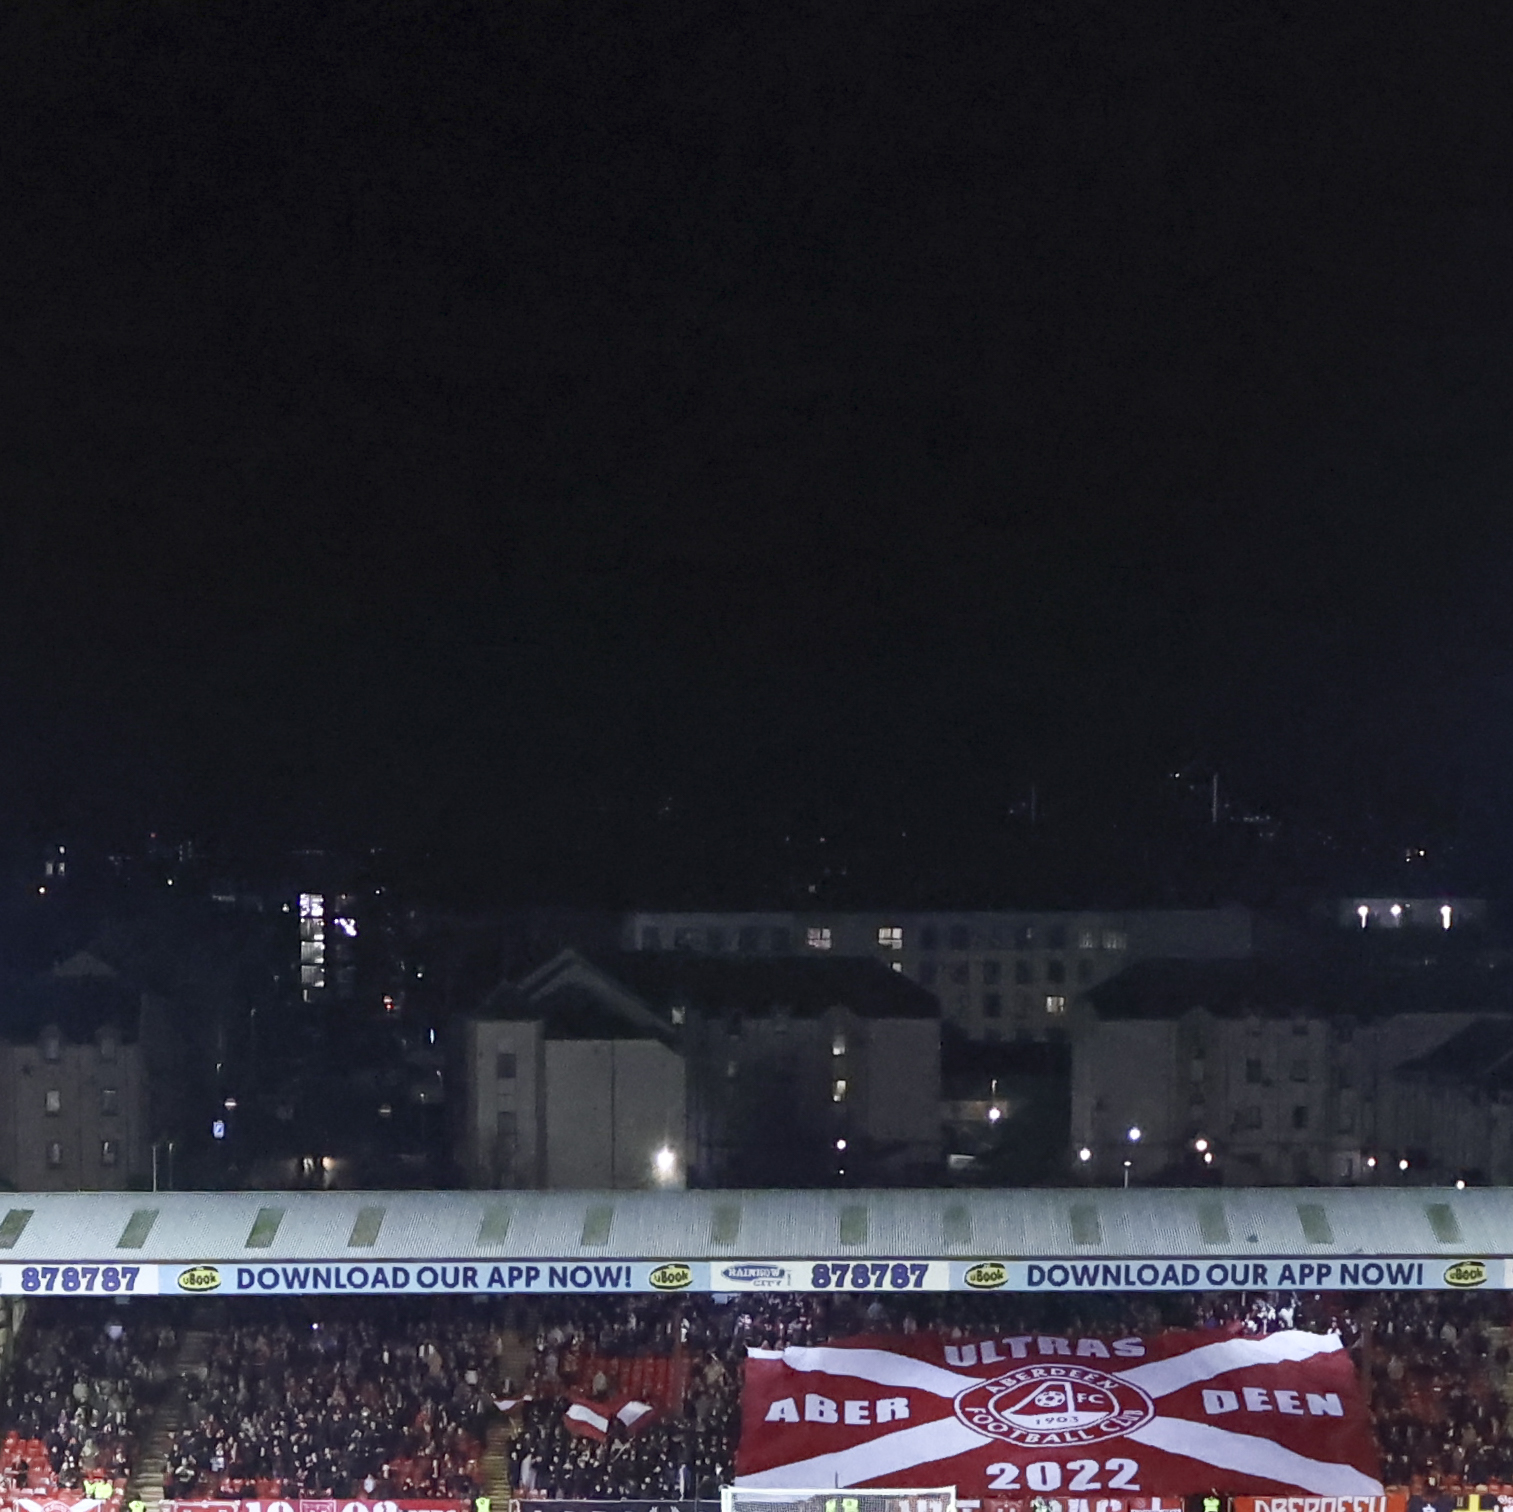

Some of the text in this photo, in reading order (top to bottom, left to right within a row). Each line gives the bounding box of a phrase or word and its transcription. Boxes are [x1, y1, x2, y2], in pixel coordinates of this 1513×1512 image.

[21, 1267, 140, 1292] 878787
[236, 1265, 633, 1290] DOWNLOAD OUR APP NOW!
[811, 1263, 929, 1289] 878787
[1027, 1264, 1200, 1287] DOWNLOAD
[1206, 1264, 1268, 1286] OUR
[1278, 1263, 1333, 1286] APP
[944, 1335, 1146, 1368] ULTRAS
[985, 1367, 1120, 1396] ABERDEEN
[764, 1388, 1345, 1426] ABER DEEN
[1076, 1392, 1105, 1405] FC
[964, 1406, 1145, 1444] FOOTBALL CLUB
[1035, 1415, 1080, 1425] 1903
[985, 1457, 1141, 1492] 2022
